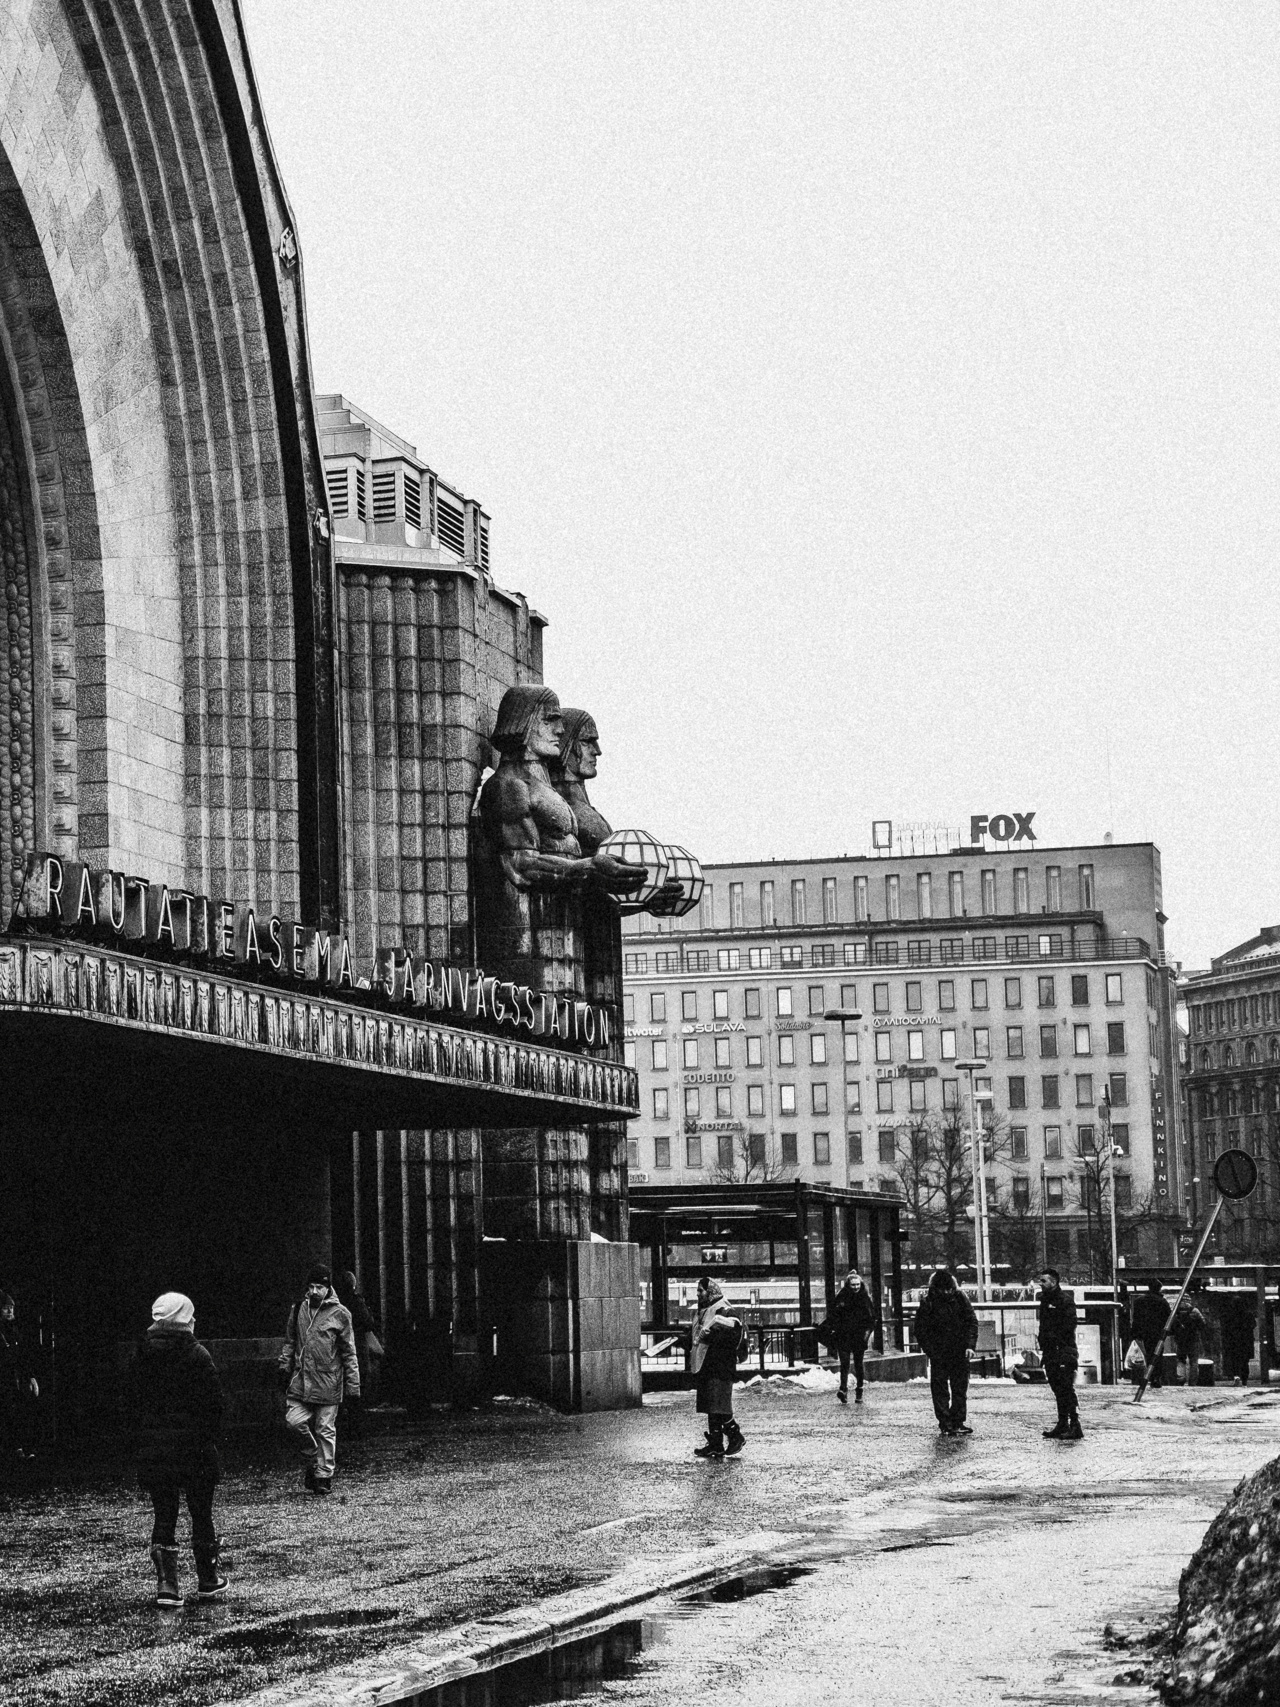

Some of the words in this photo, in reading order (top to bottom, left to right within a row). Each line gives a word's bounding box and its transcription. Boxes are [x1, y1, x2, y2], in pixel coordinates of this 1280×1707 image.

[970, 812, 1038, 843] FOX
[45, 856, 355, 988] RAUTATIEASEMA
[384, 948, 610, 1046] JÄRNVÄGSSTATION
[624, 1026, 663, 1037] ltwater
[695, 1022, 747, 1033] SULAVA
[696, 1121, 744, 1132] NORTAL
[1154, 1092, 1167, 1195] FINNKINO
